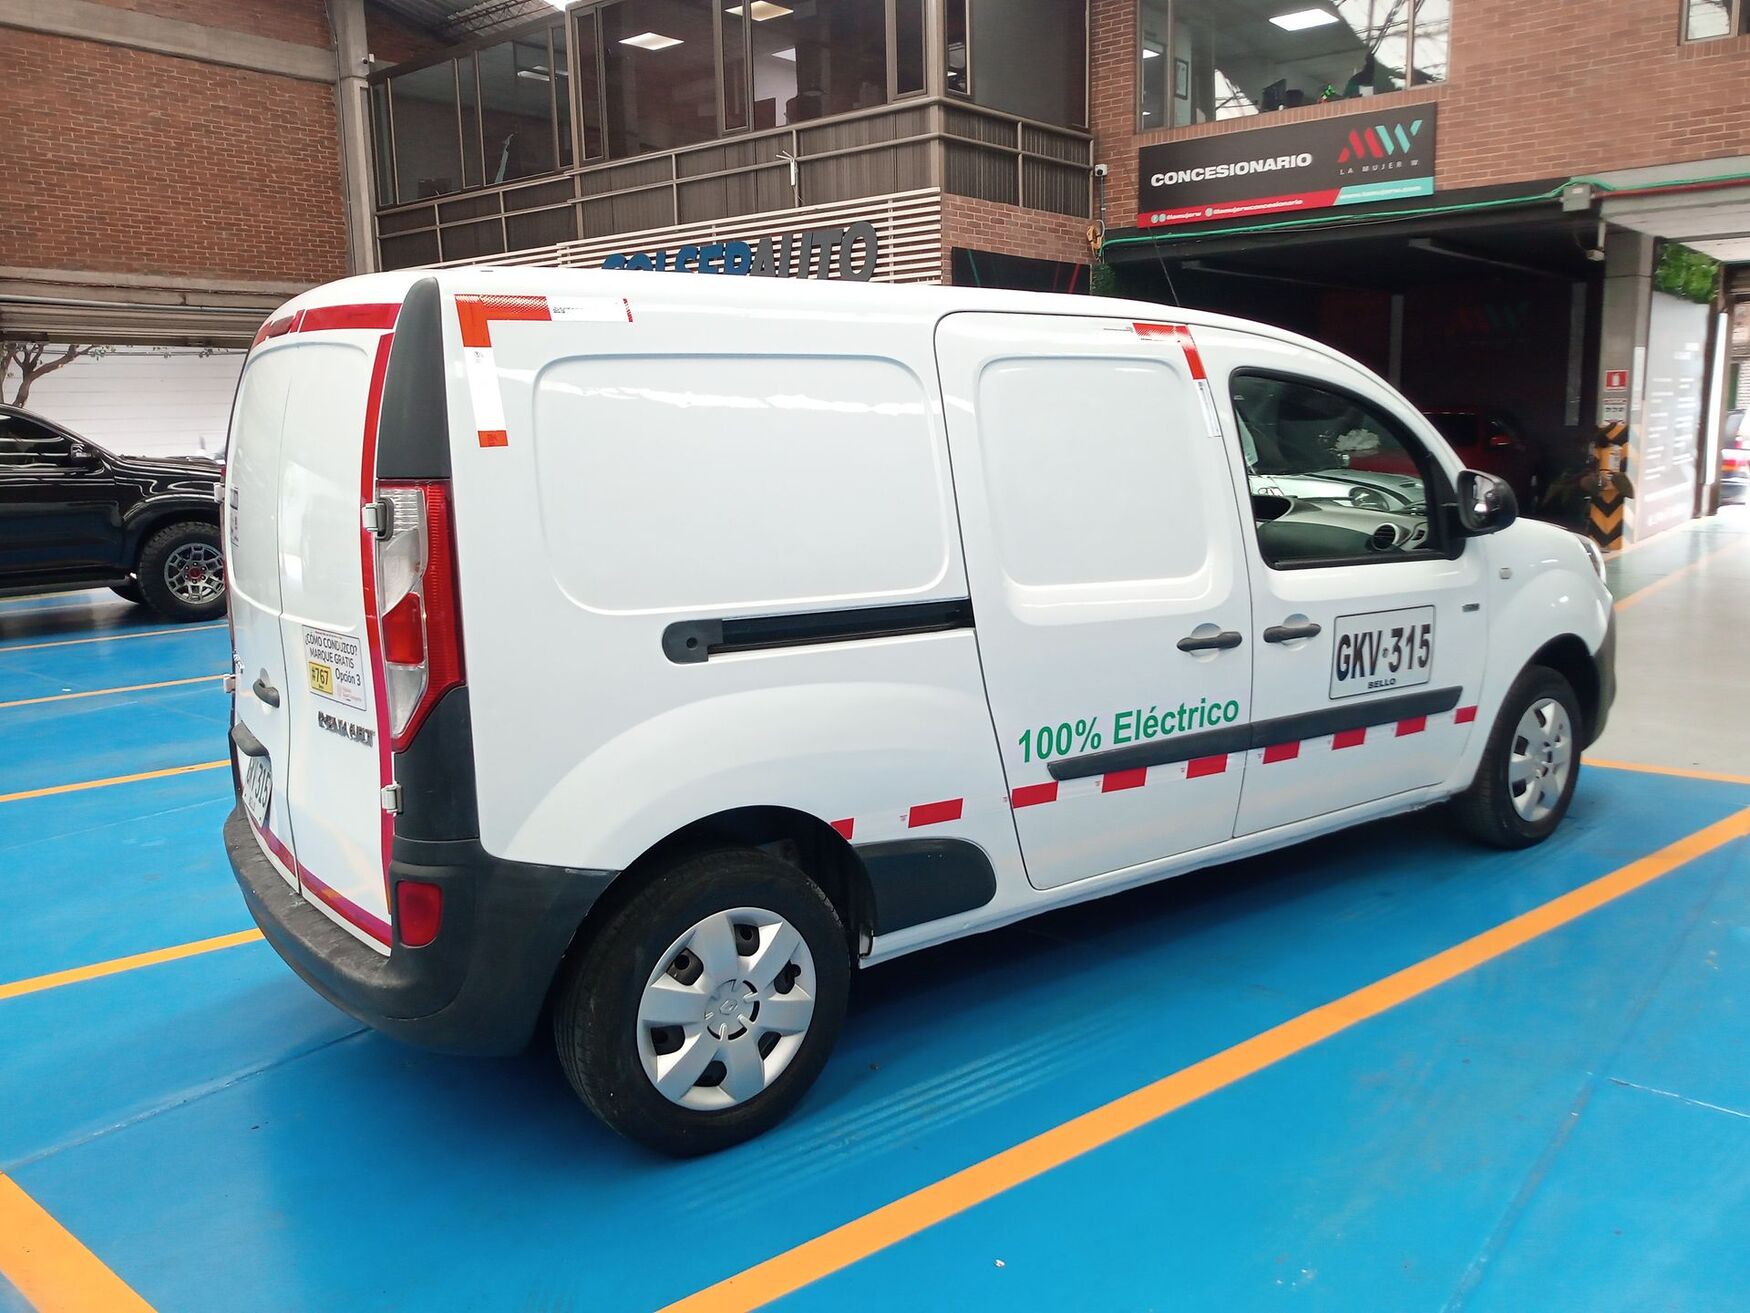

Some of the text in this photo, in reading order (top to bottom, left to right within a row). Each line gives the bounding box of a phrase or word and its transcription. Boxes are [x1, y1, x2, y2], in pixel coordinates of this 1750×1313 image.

[1150, 153, 1313, 187] CONCESIONARIO
[309, 647, 354, 669] MARQUE GRATIS
[335, 668, 361, 686] Opción 3
[1368, 678, 1396, 689] BELLO
[1018, 697, 1239, 763] 100% Eléctrico
